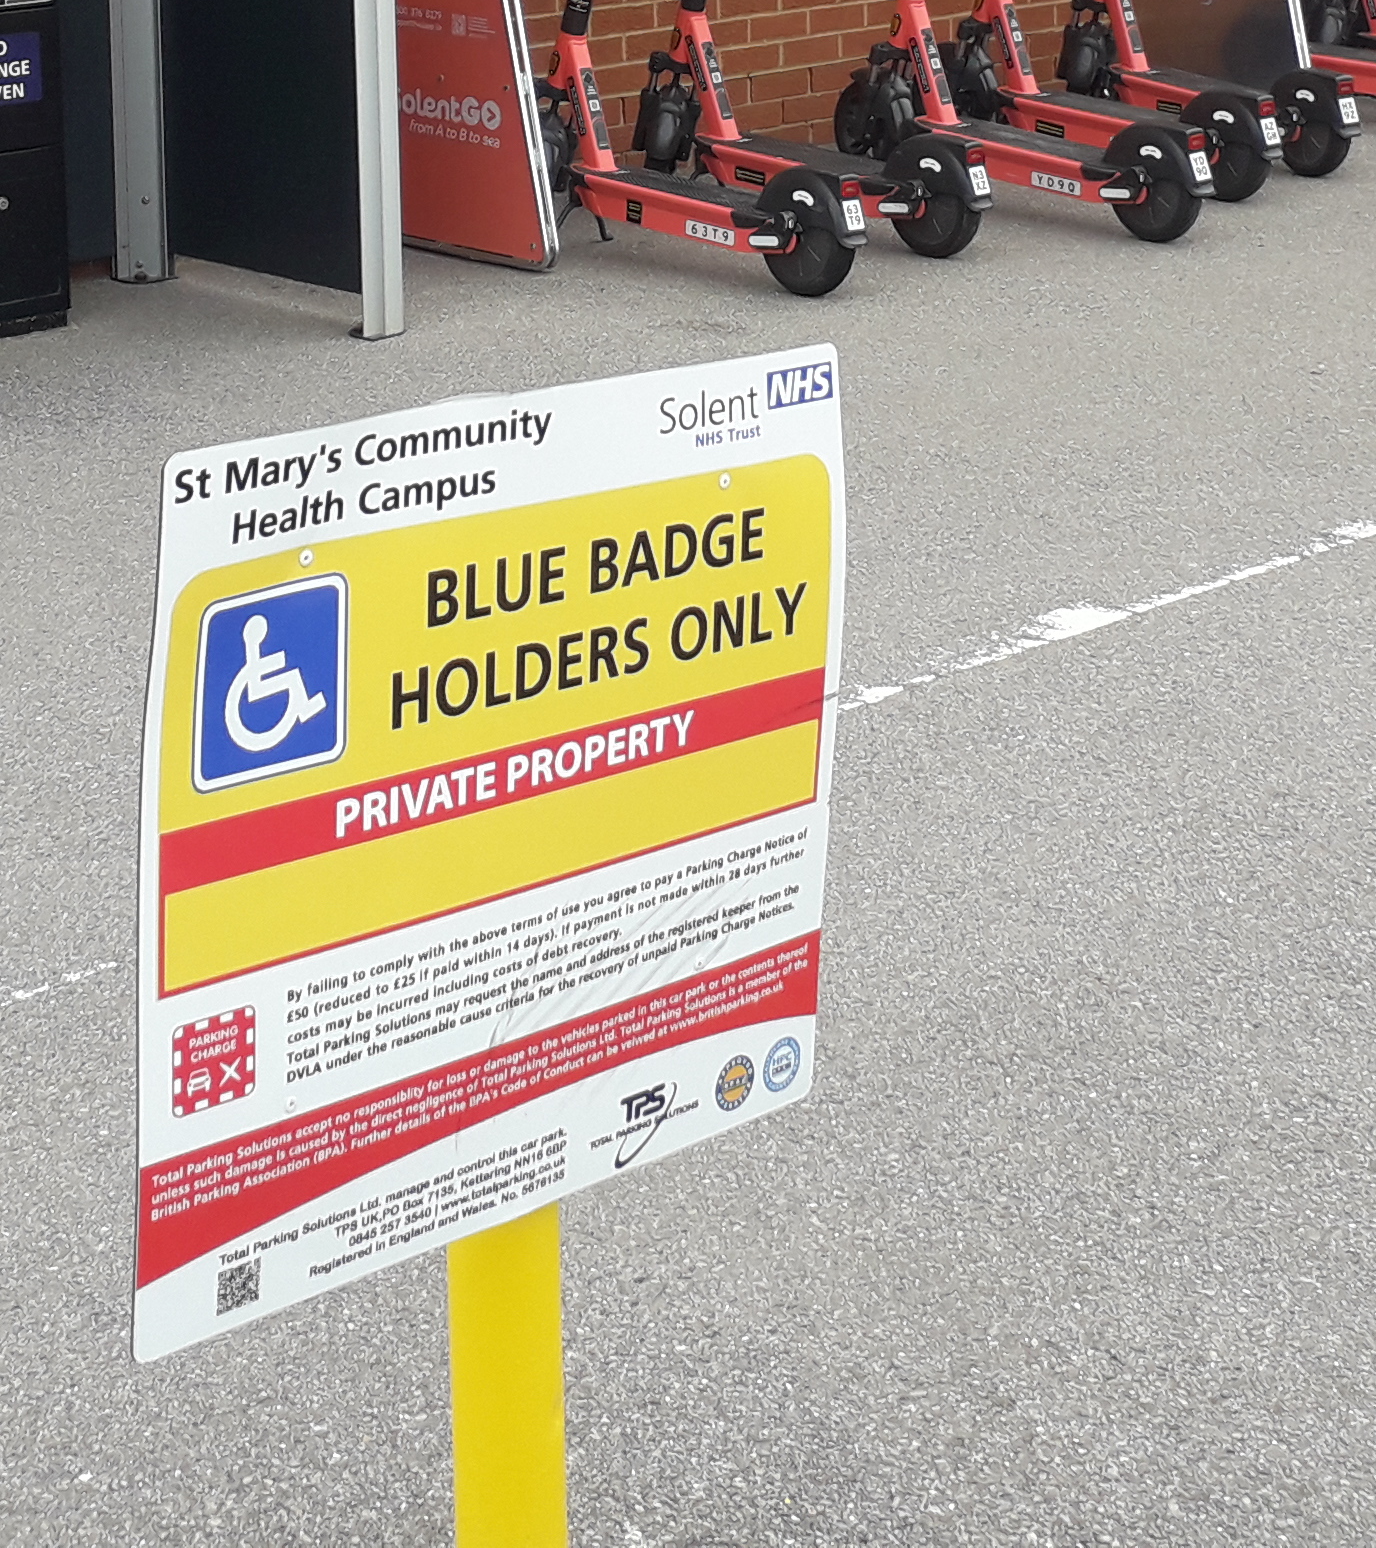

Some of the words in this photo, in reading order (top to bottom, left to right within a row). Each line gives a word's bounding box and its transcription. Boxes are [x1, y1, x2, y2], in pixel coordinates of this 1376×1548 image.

[409, 119, 434, 138] from
[435, 124, 444, 138] A
[446, 126, 456, 139] to
[458, 128, 468, 141] B
[469, 128, 481, 143] to
[482, 133, 501, 148] sea
[846, 203, 859, 215] 63
[849, 215, 861, 226] T9
[691, 223, 729, 242] 63T9
[660, 386, 759, 434] Solent
[768, 363, 832, 409] NHS
[175, 468, 212, 504] St
[225, 443, 343, 493] Mary's
[354, 409, 553, 466] Community
[695, 430, 723, 448] NHS
[727, 424, 761, 443] Trust
[232, 490, 345, 545] Health
[359, 470, 497, 513] Campus
[427, 545, 567, 628] BLUE
[590, 507, 766, 594] BADGE
[391, 616, 650, 731] HOLDERS
[671, 582, 808, 662] ONLY
[335, 761, 497, 839] PRIVATE
[507, 709, 696, 794] PROPERTY
[287, 987, 302, 1006] By
[307, 972, 348, 1000] failing
[352, 967, 366, 983] to
[369, 952, 414, 980] comply
[417, 942, 445, 962] with
[448, 934, 469, 952] the
[471, 922, 508, 945] above
[510, 911, 543, 932] terms
[545, 906, 558, 921] of
[561, 901, 580, 916] use
[582, 894, 604, 912] you
[606, 883, 637, 904] agree
[639, 876, 652, 891] to
[653, 872, 674, 889] pay
[676, 869, 683, 880] a
[685, 853, 724, 879] Parking
[725, 841, 762, 866] Charge
[763, 831, 795, 852] Notice
[796, 827, 808, 841] of
[287, 1023, 321, 1045] costs
[325, 1015, 352, 1035] may
[356, 1006, 372, 1023] be
[376, 987, 429, 1016] incurred
[432, 968, 489, 1000] including
[492, 957, 523, 978] costs
[525, 952, 539, 967] of
[541, 942, 569, 962] debt
[571, 927, 622, 955] recovery.
[189, 1024, 239, 1050] PARKING
[190, 1038, 237, 1063] CHARGE
[620, 1081, 667, 1124] TPS
[590, 1133, 614, 1151] TOTAL
[615, 1119, 652, 1141] PARKING
